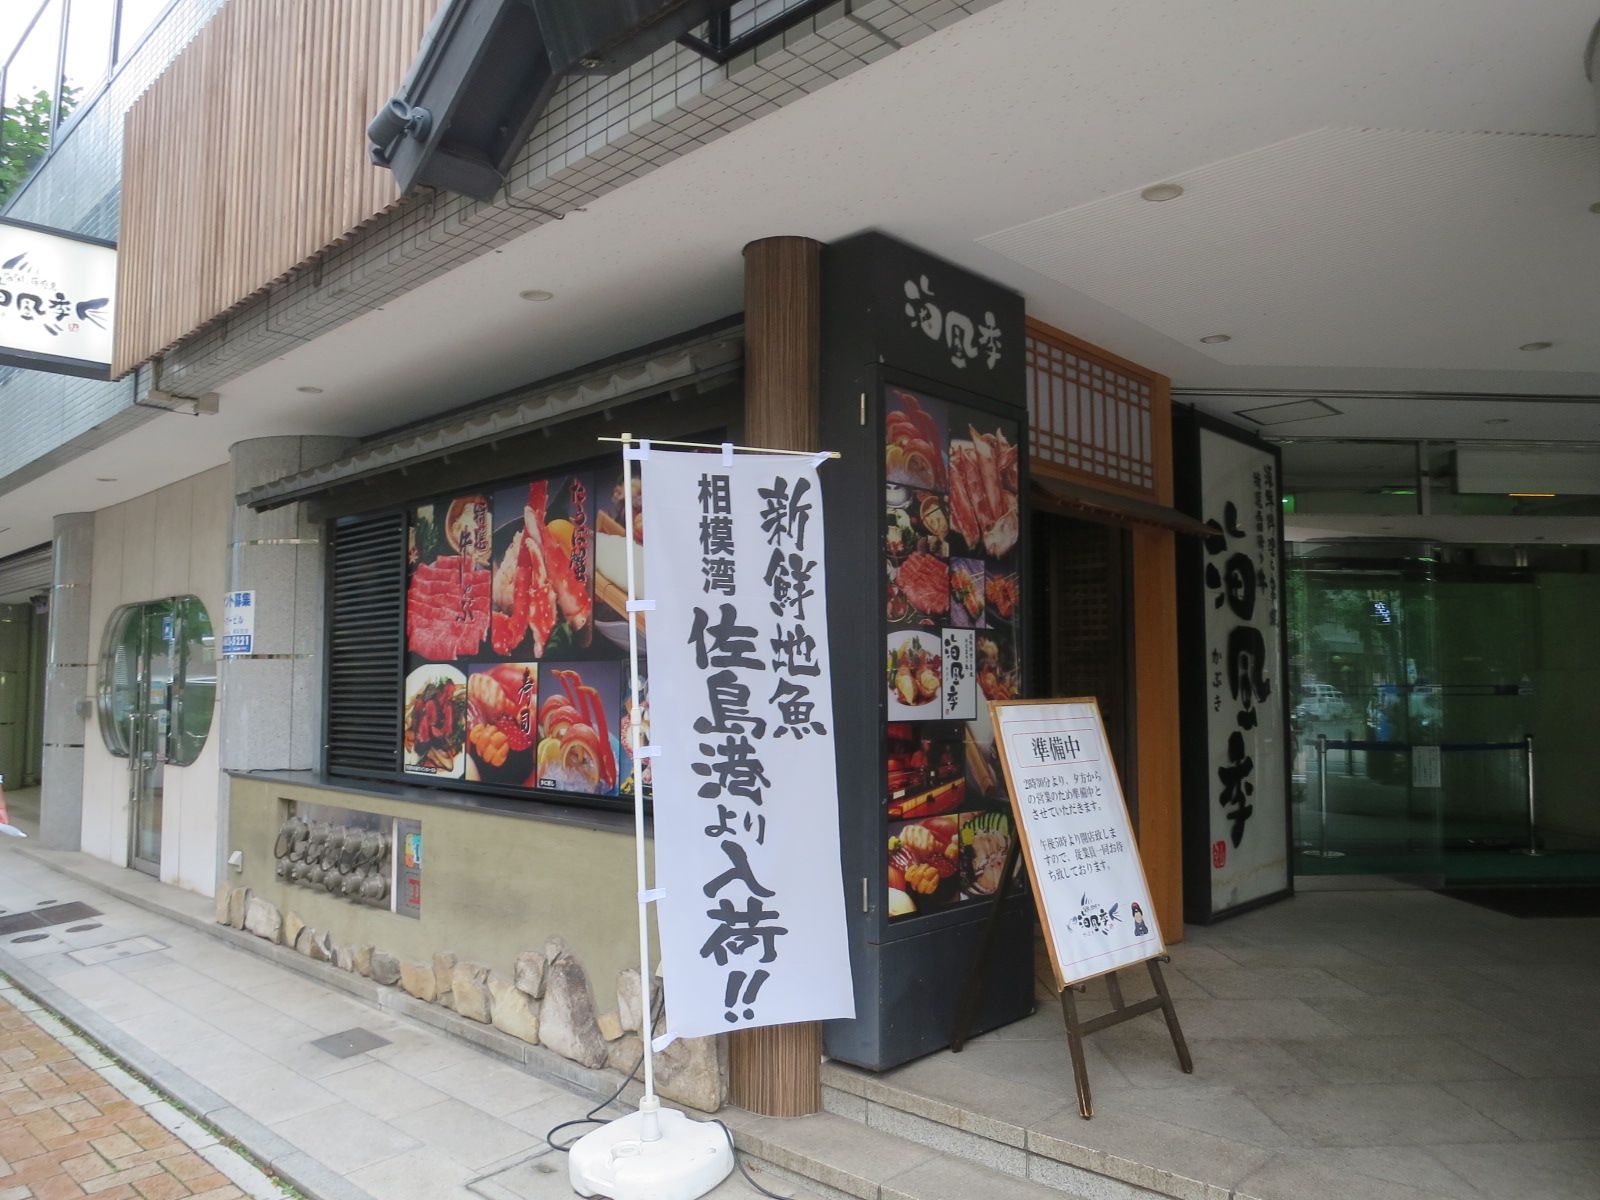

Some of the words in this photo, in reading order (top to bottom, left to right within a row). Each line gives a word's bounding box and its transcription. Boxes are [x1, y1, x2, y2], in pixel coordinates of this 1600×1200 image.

[757, 476, 828, 739] 新鮮地魚
[1031, 735, 1080, 762] 準備中
[1031, 801, 1102, 821] させていただきます。
